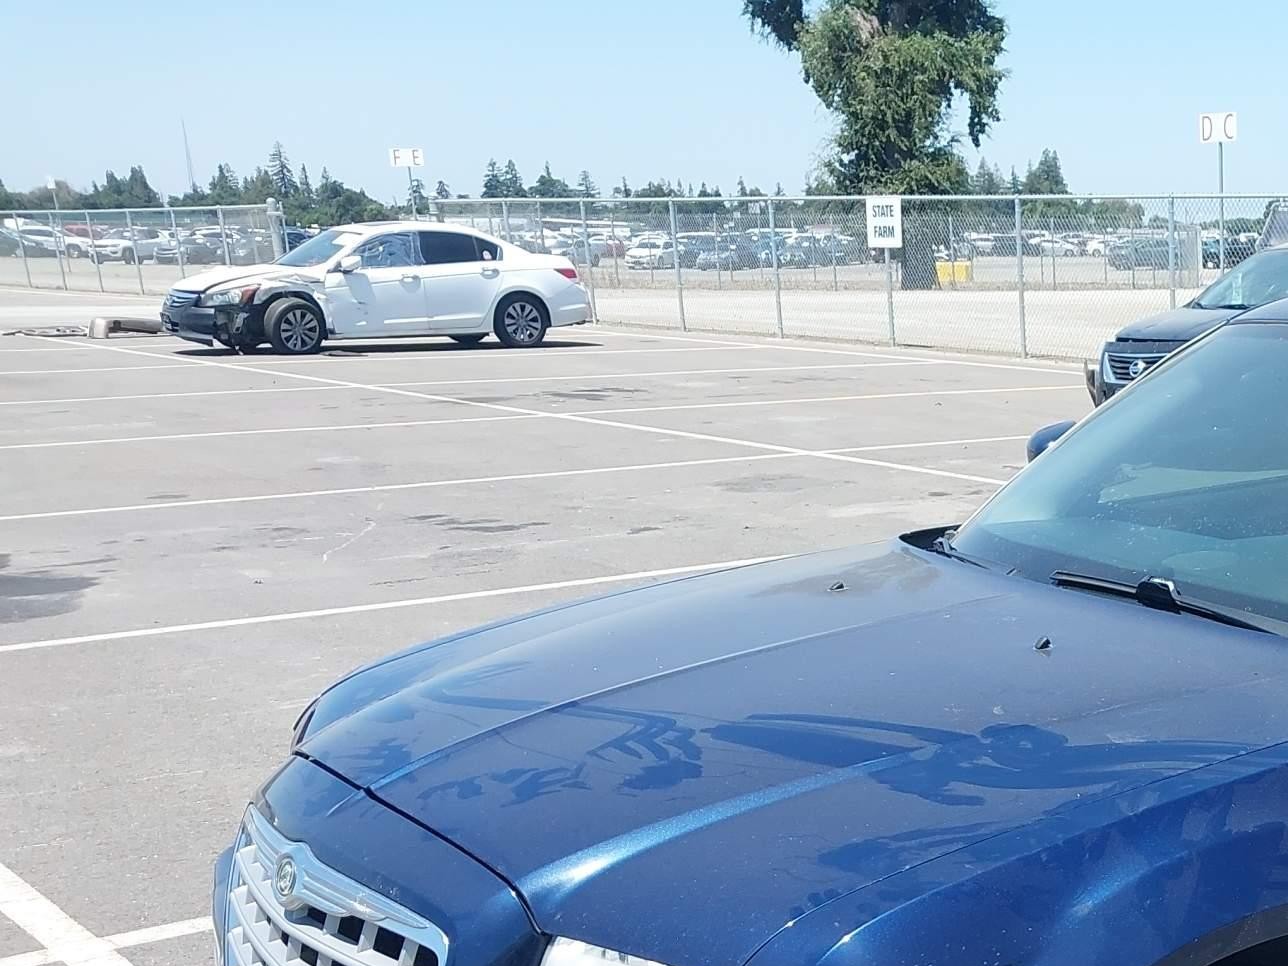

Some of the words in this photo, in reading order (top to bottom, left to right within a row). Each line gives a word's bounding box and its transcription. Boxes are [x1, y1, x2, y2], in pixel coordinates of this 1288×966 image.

[1202, 116, 1213, 142] D
[1224, 113, 1235, 140] C
[393, 149, 401, 166] F
[412, 149, 422, 166] E
[872, 204, 895, 218] STATE
[873, 225, 896, 239] FARM
